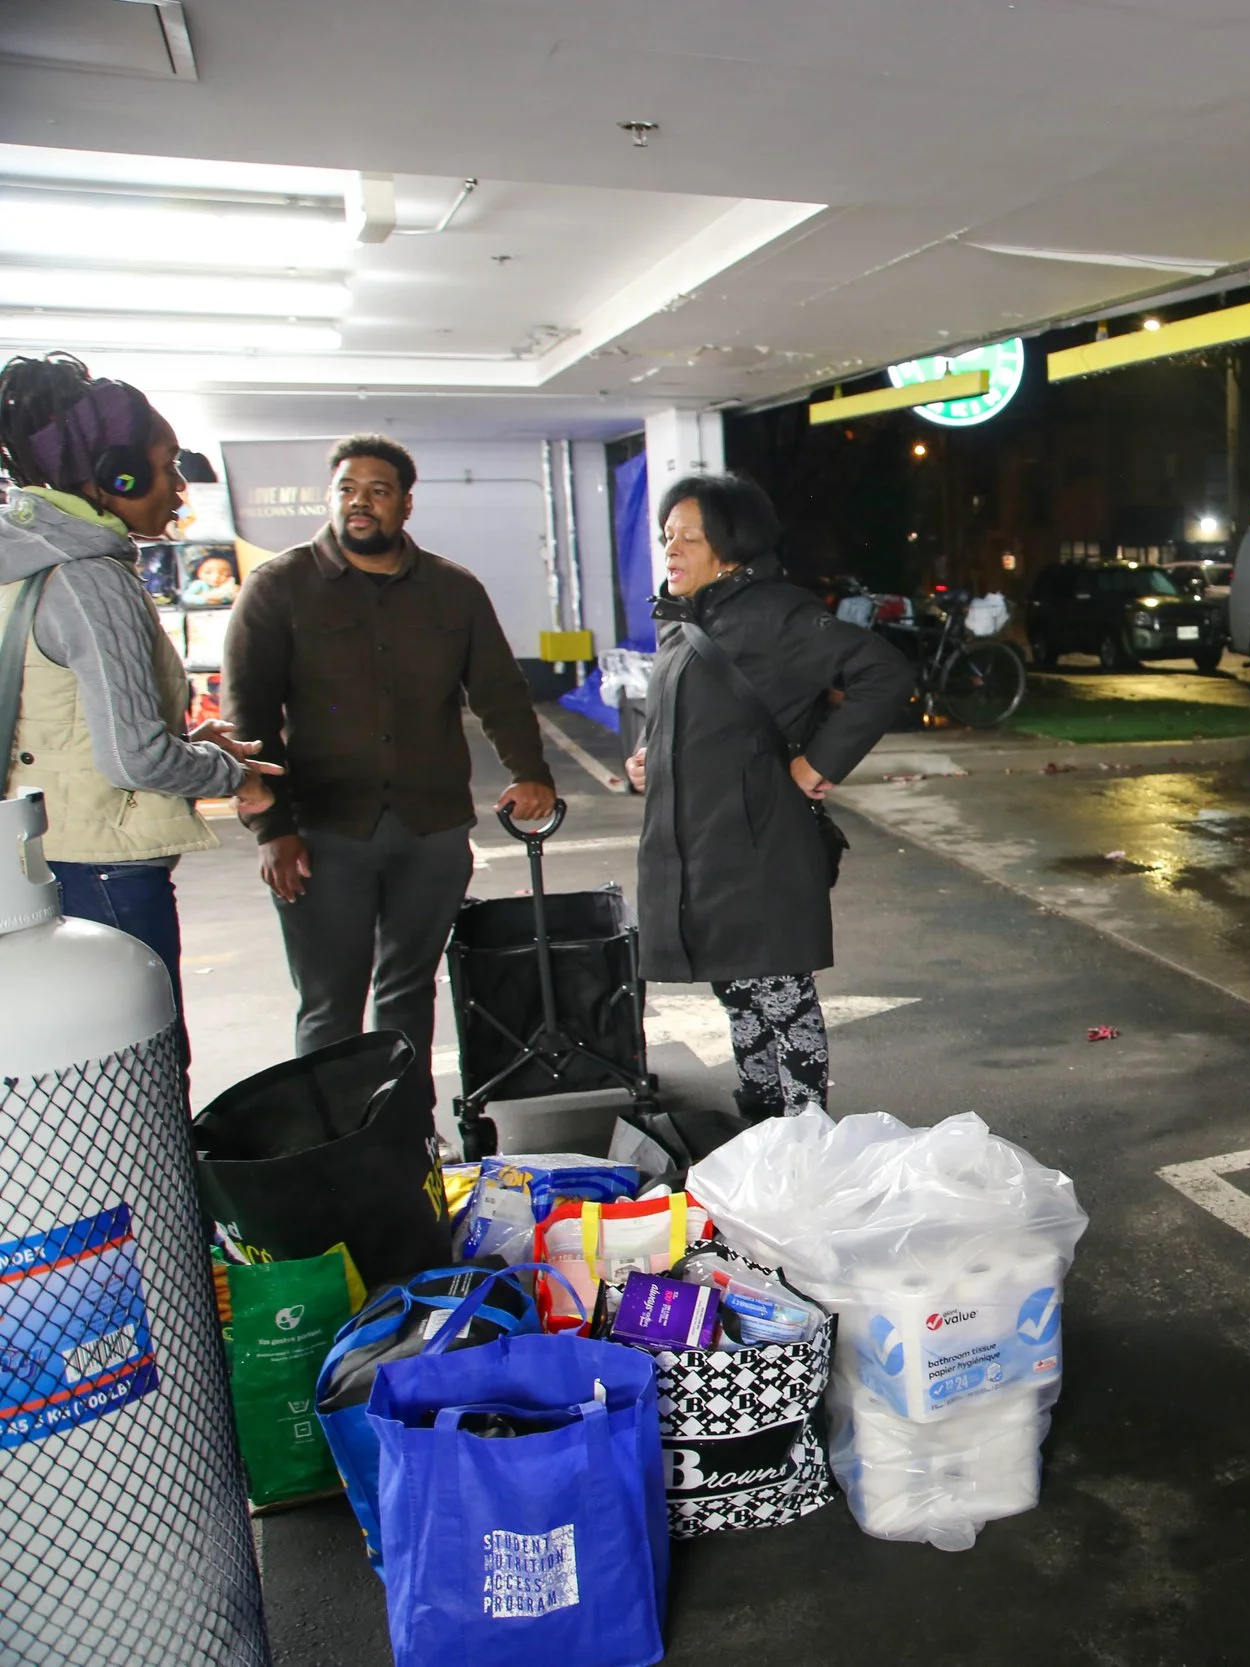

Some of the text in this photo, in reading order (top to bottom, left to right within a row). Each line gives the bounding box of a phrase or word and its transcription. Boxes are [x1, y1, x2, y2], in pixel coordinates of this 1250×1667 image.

[643, 1283, 660, 1312] always
[944, 1310, 977, 1326] value
[928, 1343, 997, 1368] bathroom tissue
[928, 1364, 956, 1380] papier
[7, 1414, 44, 1435] 455
[484, 1534, 549, 1555] STUDENT
[484, 1575, 542, 1593] ACCESS
[484, 1590, 557, 1614] PROGRAM
